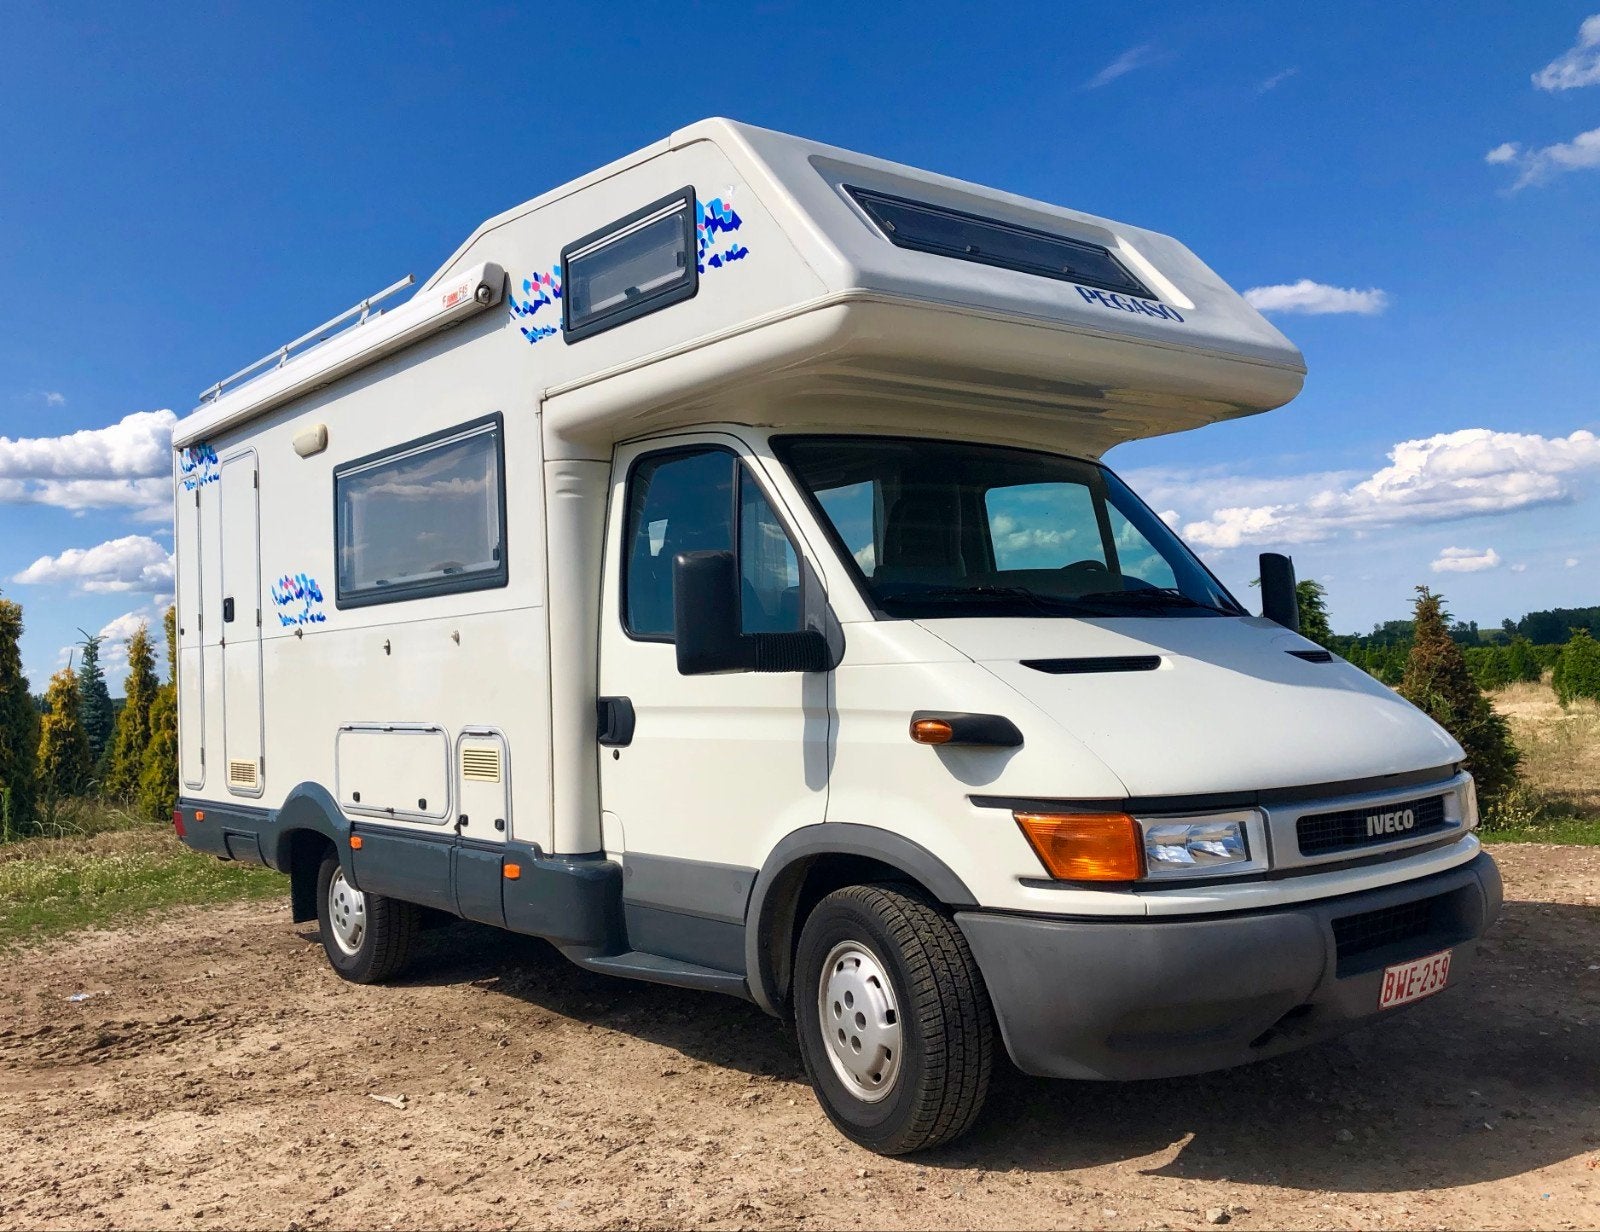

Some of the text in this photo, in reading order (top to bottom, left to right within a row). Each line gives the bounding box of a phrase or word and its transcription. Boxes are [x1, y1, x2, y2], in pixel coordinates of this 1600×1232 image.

[1074, 285, 1185, 323] PEGASO
[1366, 809, 1415, 837] IVECO
[1383, 956, 1449, 1003] BWE-259
